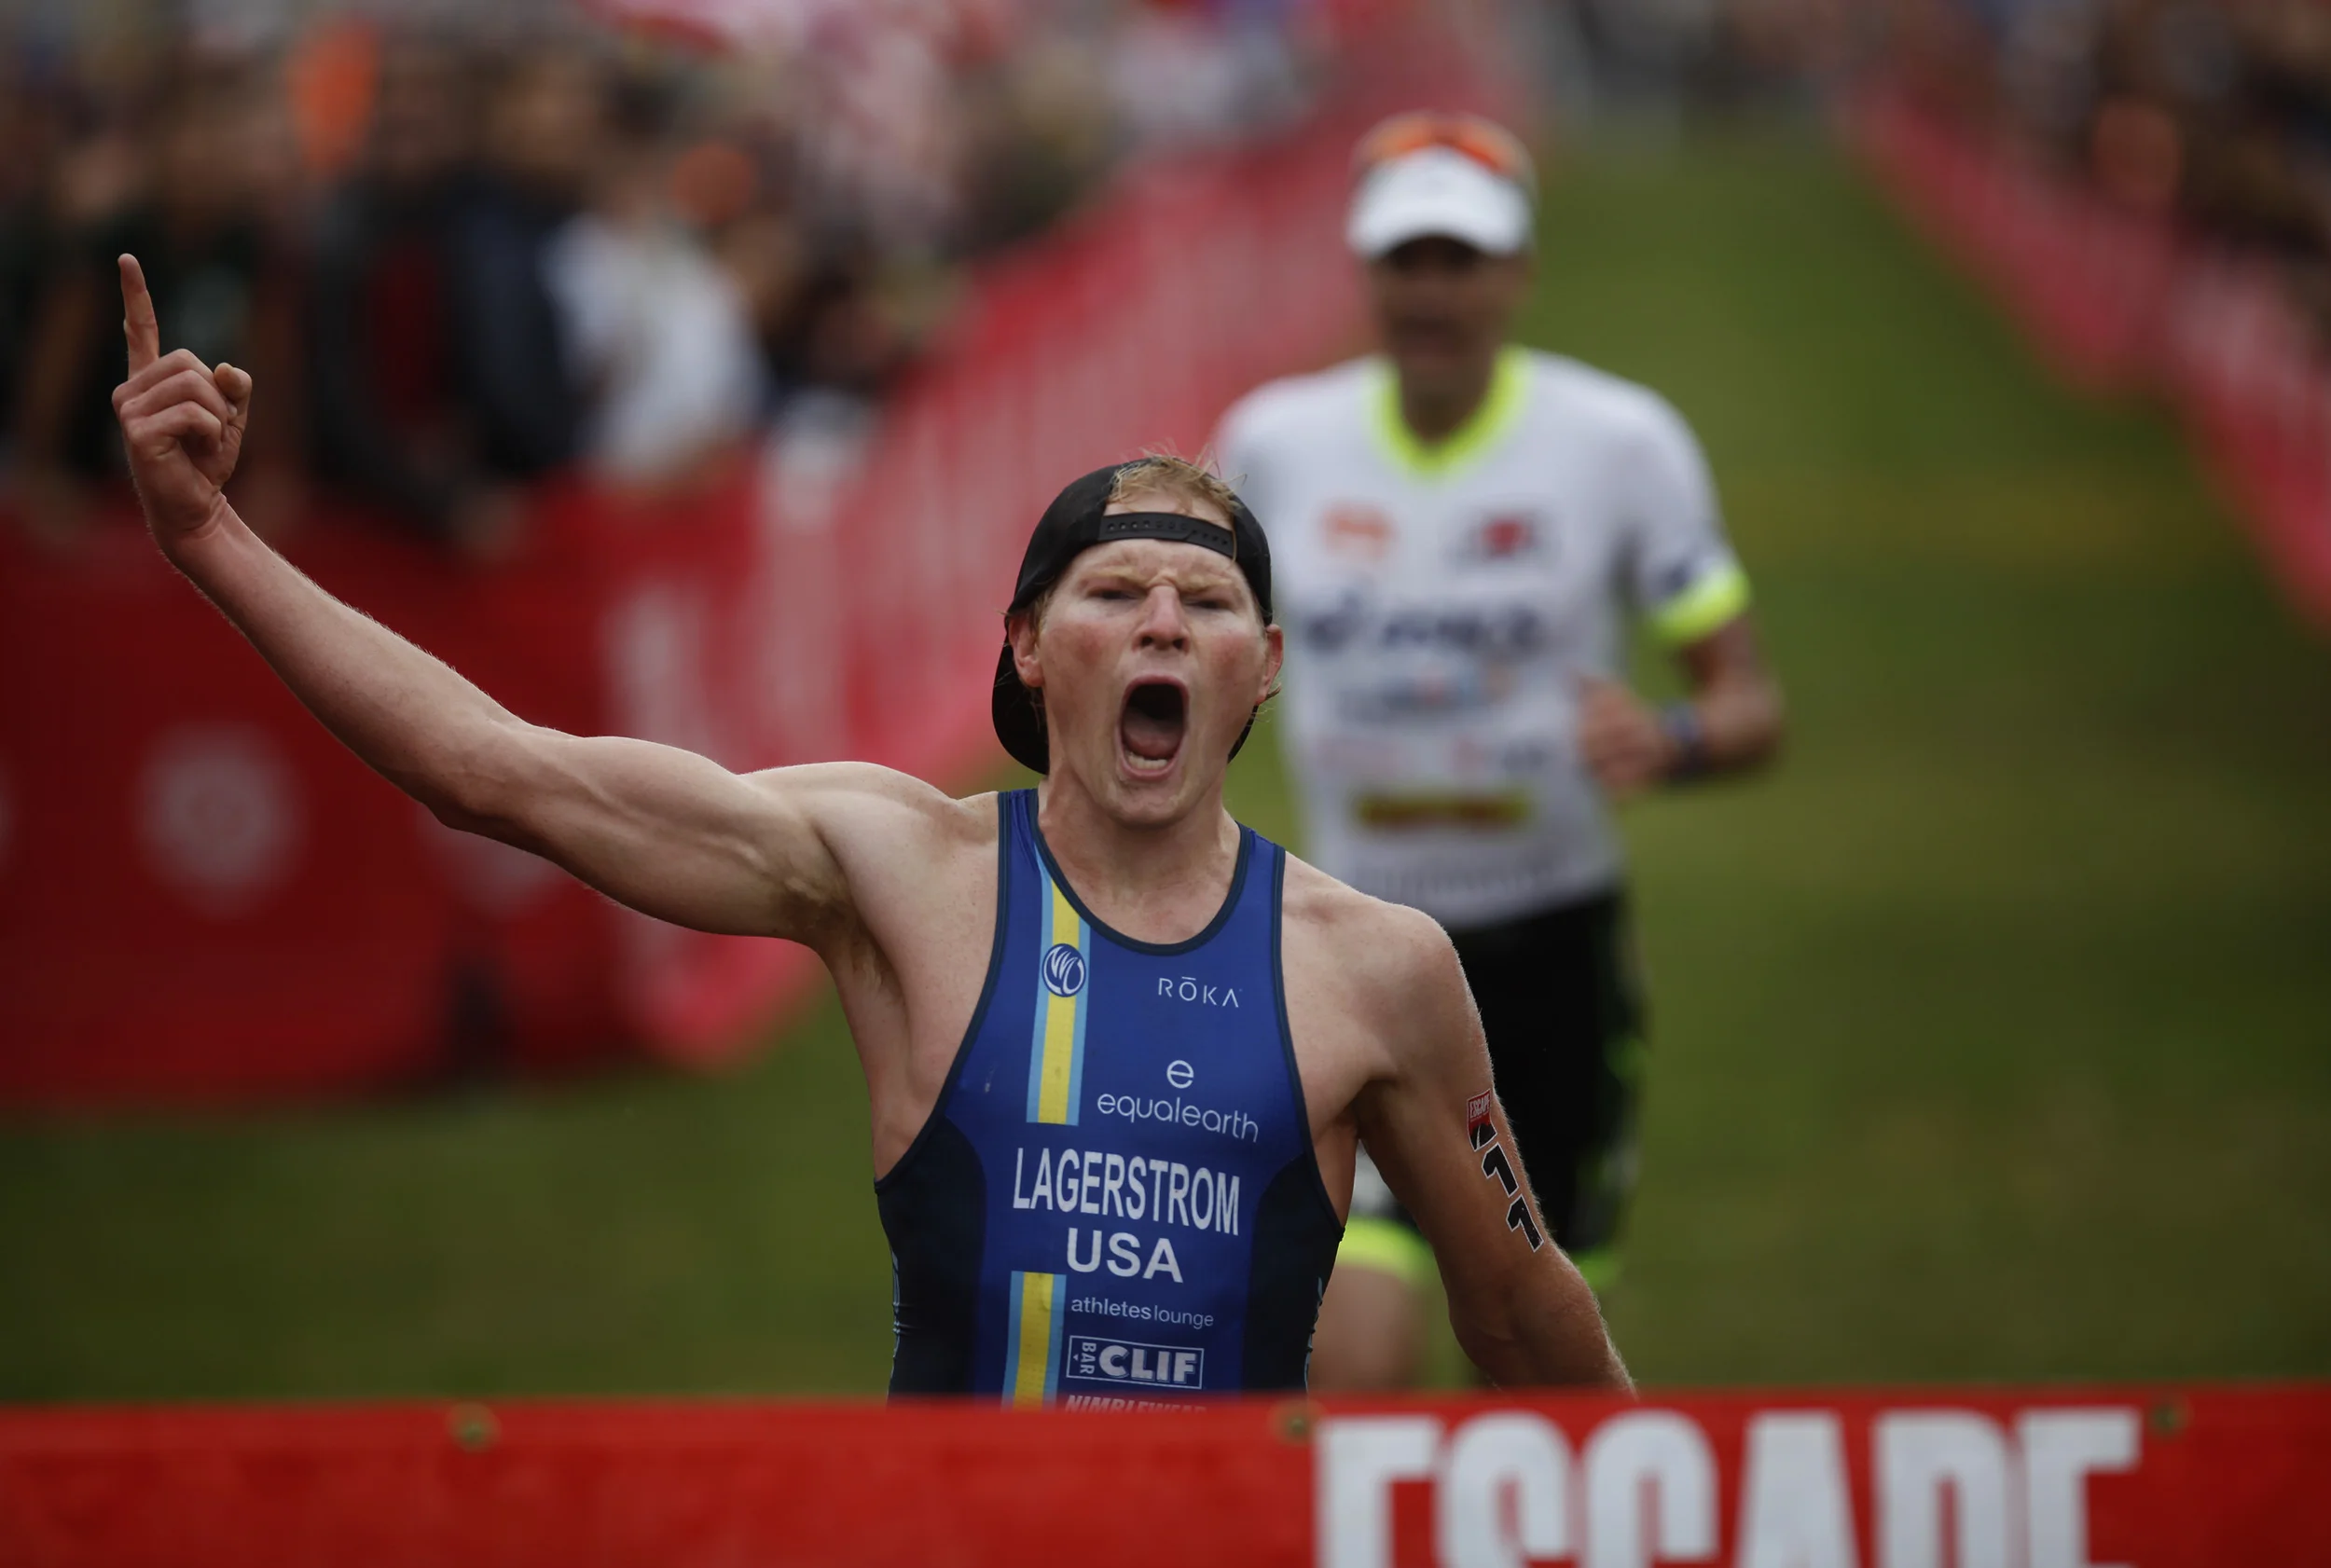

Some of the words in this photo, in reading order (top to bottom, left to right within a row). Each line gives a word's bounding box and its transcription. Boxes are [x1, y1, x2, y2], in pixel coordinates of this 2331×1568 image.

[1097, 1093, 1259, 1143] equalearth
[1013, 1148, 1240, 1235] LAGERSTROM
[1067, 1227, 1183, 1284] USA
[1080, 1341, 1097, 1374] BAR
[1098, 1345, 1197, 1384] CLIF
